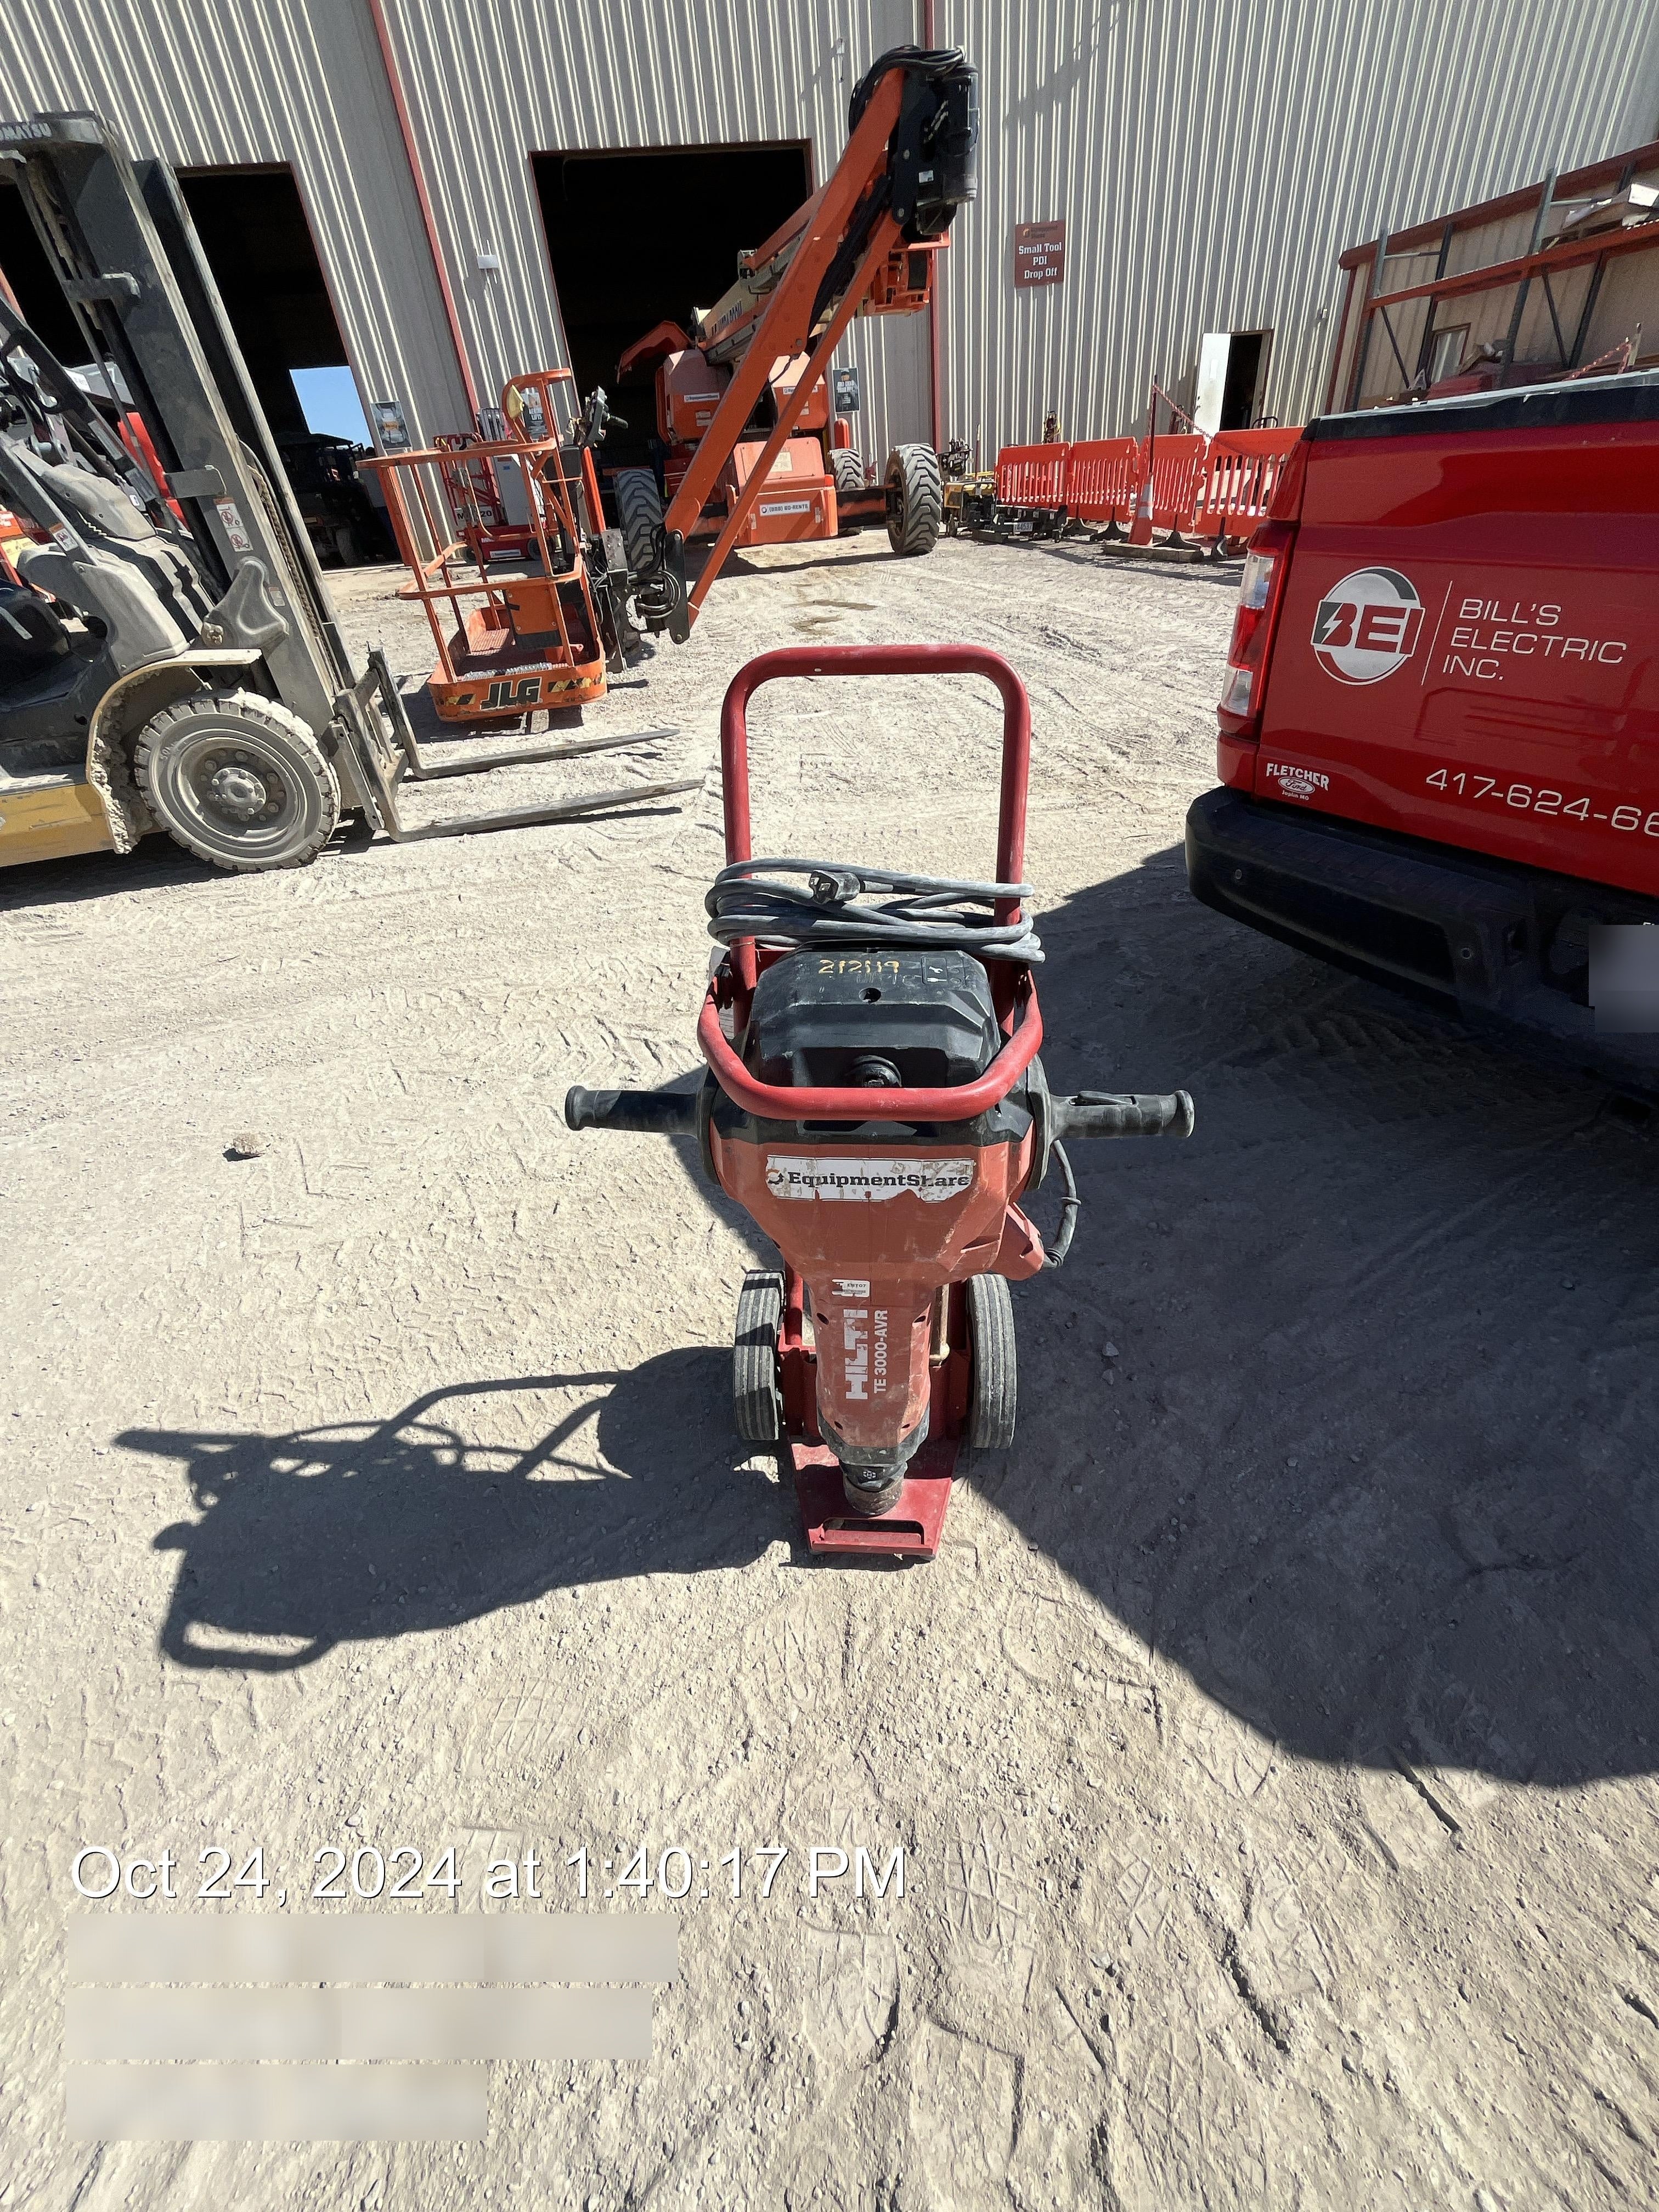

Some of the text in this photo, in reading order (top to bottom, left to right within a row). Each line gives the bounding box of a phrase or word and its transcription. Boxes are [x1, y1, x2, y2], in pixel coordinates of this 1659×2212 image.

[0, 122, 52, 140] MATSU
[1018, 242, 1062, 255] Small Tool
[1032, 255, 1047, 266] PDI
[1024, 267, 1058, 280] Drop Off
[1459, 598, 1562, 626] BILL'S
[1450, 628, 1627, 664] ELECTRIC
[1442, 654, 1504, 681] INC.
[479, 676, 542, 710] JLG
[1266, 763, 1329, 791] FLETCHER
[1286, 779, 1308, 791] Ford
[1282, 789, 1299, 798] Joplin
[788, 1171, 969, 1188] EquipmentShare
[843, 1309, 868, 1400] HILTI
[874, 1310, 888, 1394] TE 3000-AVR
